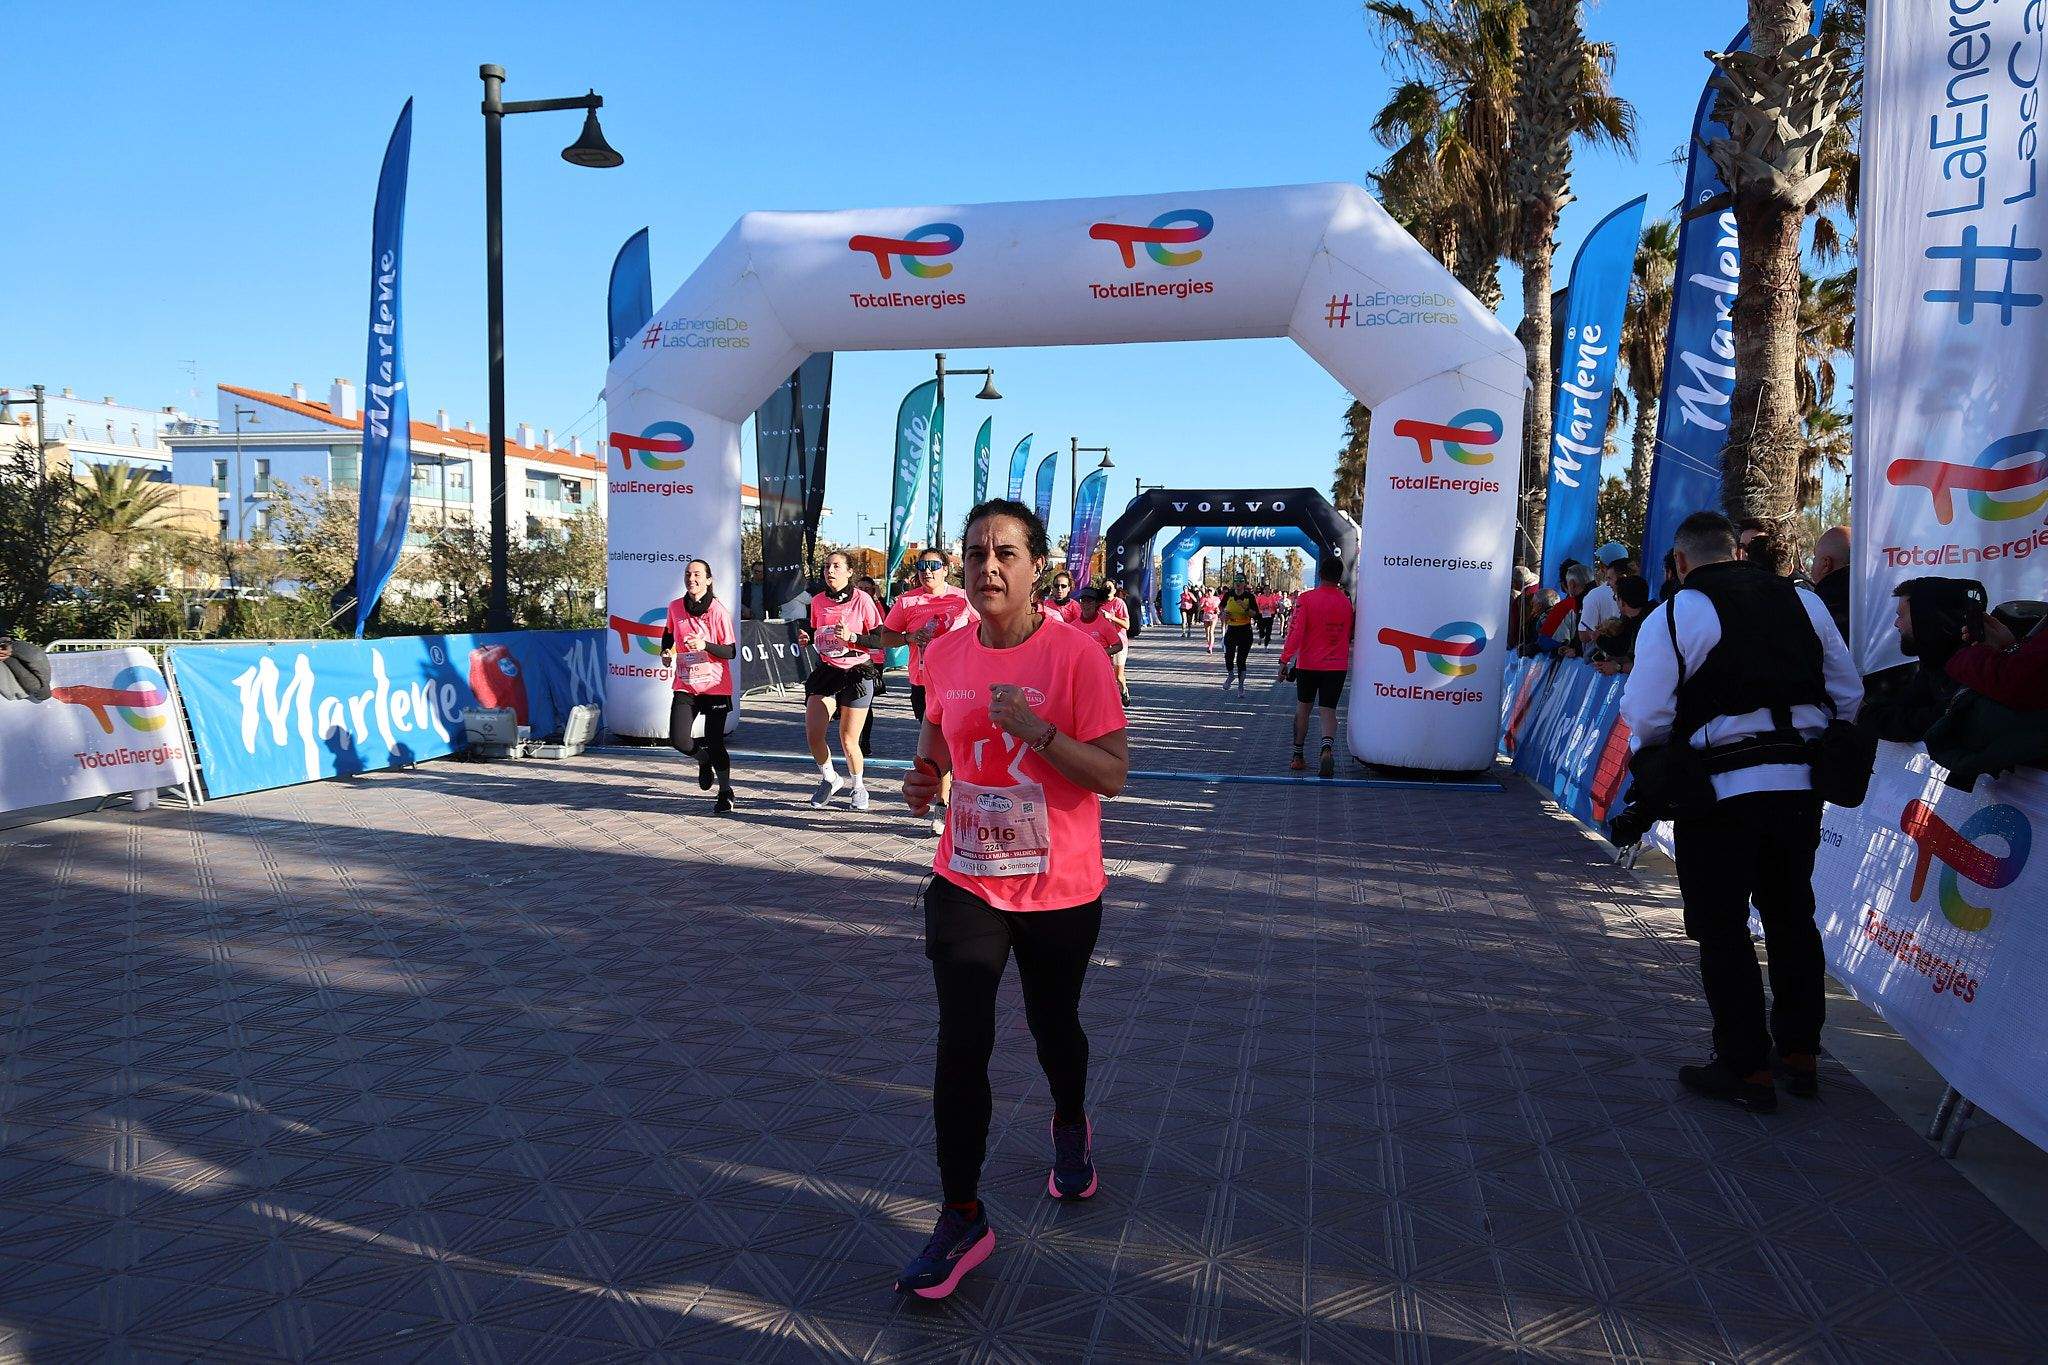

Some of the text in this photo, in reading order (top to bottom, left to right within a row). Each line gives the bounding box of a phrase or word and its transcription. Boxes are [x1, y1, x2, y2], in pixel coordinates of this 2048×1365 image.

[1088, 278, 1214, 300] TotalEnergies
[849, 290, 966, 309] TotalEnergies
[1356, 309, 1459, 326] LasCarreras
[1675, 210, 1740, 431] Marlen
[368, 250, 404, 439] Marlene
[662, 333, 750, 348] LasCarreras
[1554, 324, 1608, 488] Marlene
[764, 474, 804, 482] VOVO
[1389, 475, 1499, 493] TotalEnergies
[609, 481, 694, 496] TotalEnergies
[1172, 501, 1286, 512] VOLVO
[1226, 526, 1276, 544] Marlene
[608, 551, 692, 563] totalenergies.es
[1383, 555, 1492, 570] totalenergies.es
[1116, 545, 1125, 589] LVO
[741, 643, 800, 662] OLVO
[608, 663, 673, 681] otalEnergi
[946, 689, 976, 700] OYSHO
[1373, 682, 1483, 705] TotalEnergies
[231, 648, 463, 780] Marlene
[74, 744, 183, 770] TotalEnergies
[977, 826, 1016, 841] 016
[1007, 862, 1039, 870] Santander
